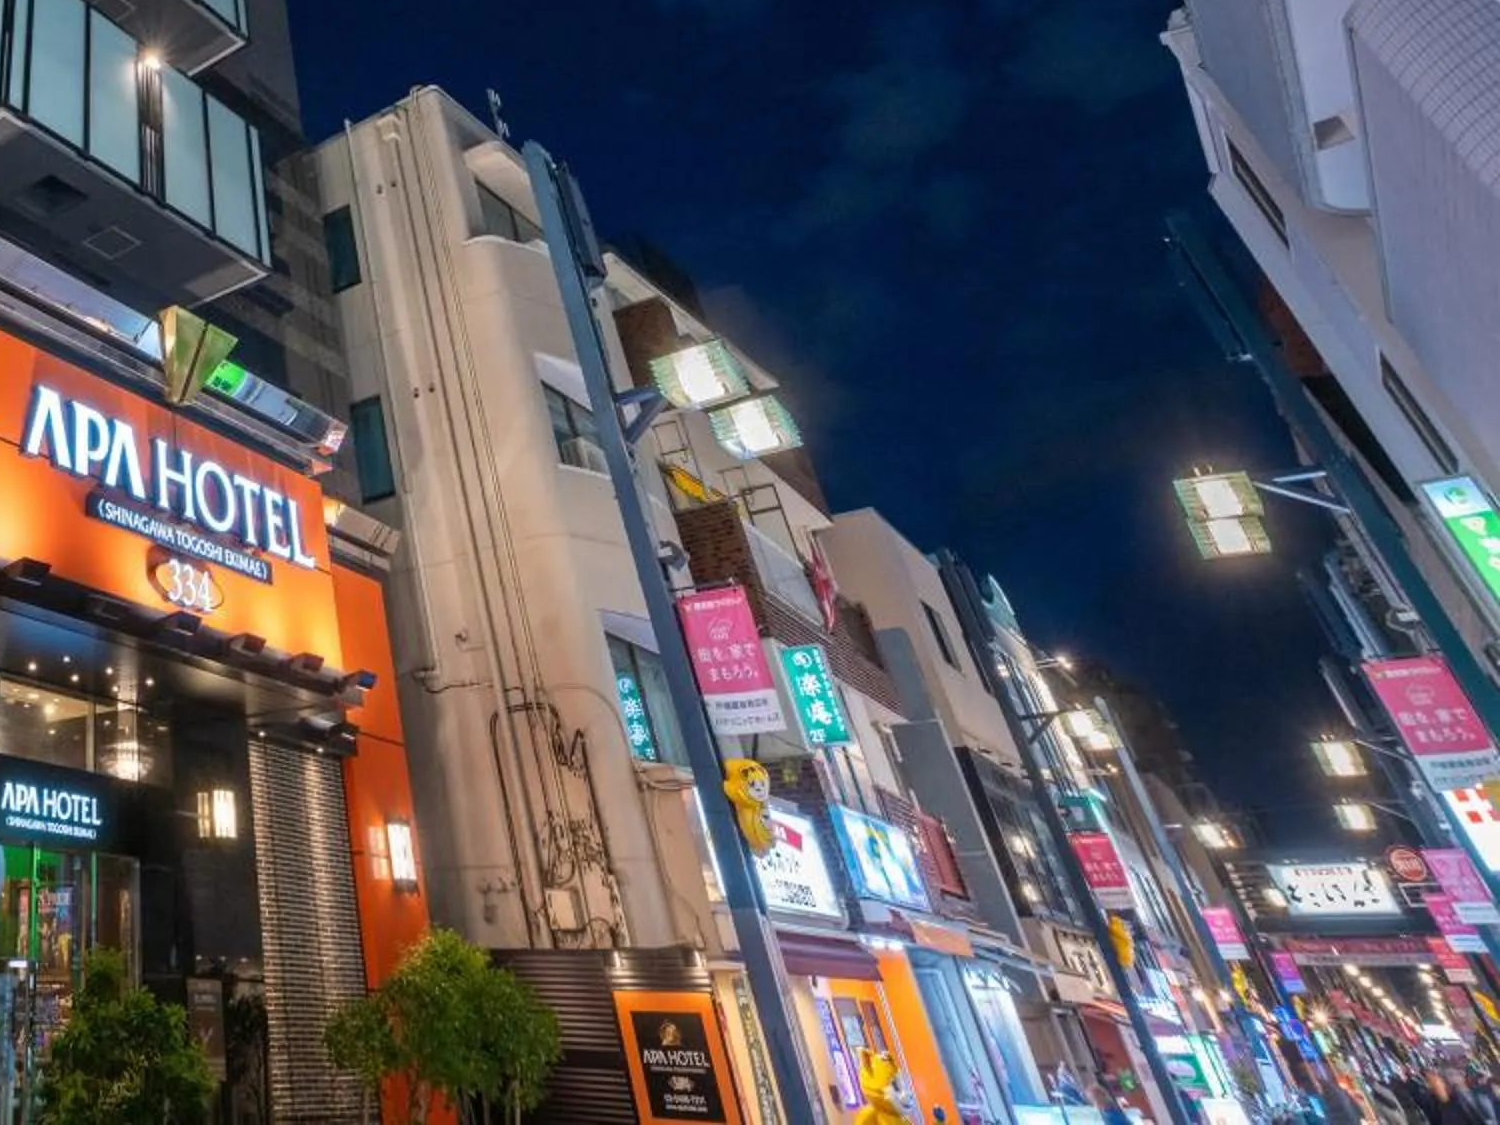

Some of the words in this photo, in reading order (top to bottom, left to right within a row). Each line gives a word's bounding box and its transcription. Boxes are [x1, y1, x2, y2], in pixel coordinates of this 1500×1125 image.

[21, 384, 146, 500] APA
[157, 438, 316, 568] HOTEL
[176, 529, 223, 561] TOGOSHI
[167, 558, 213, 612] 334
[1, 781, 40, 816] APA
[42, 787, 103, 826] HOTEL
[643, 1049, 668, 1065] APA
[668, 1050, 711, 1068] HOTEL
